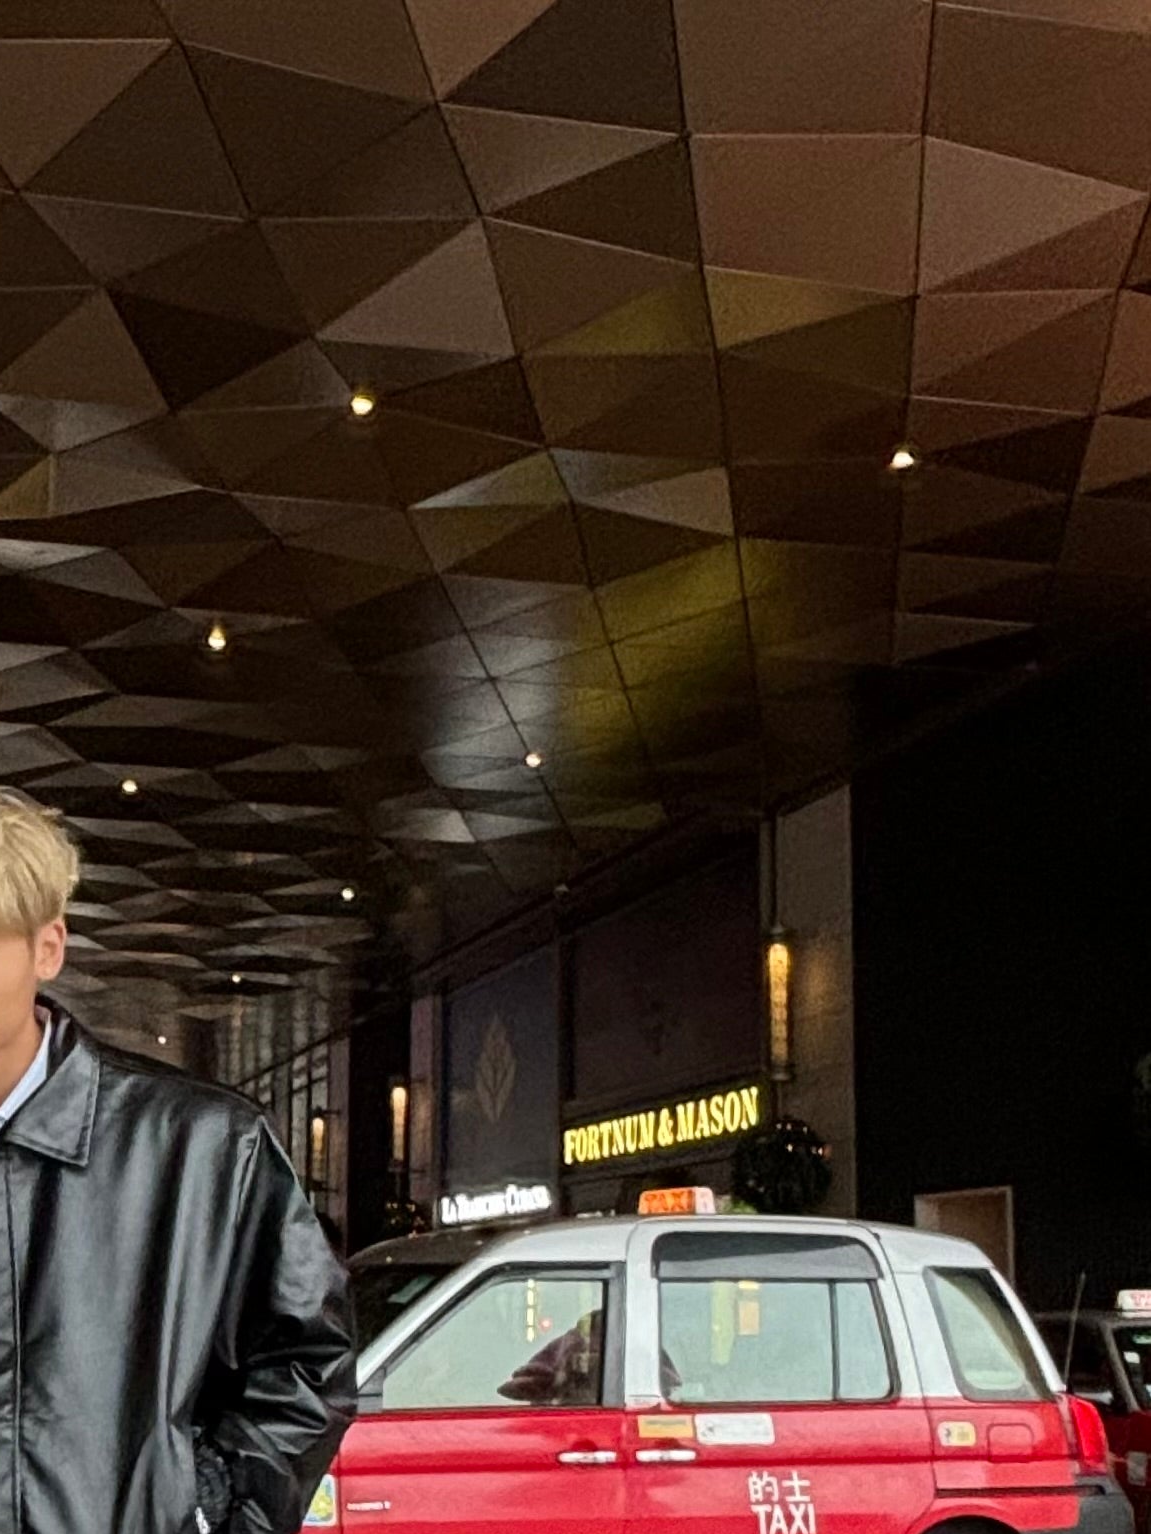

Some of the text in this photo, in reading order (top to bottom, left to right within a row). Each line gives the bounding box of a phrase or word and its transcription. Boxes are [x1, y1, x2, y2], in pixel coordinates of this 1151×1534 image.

[563, 1085, 759, 1166] FORTNUM & MASON
[644, 1189, 694, 1213] TAXI
[748, 1470, 811, 1503] 的士
